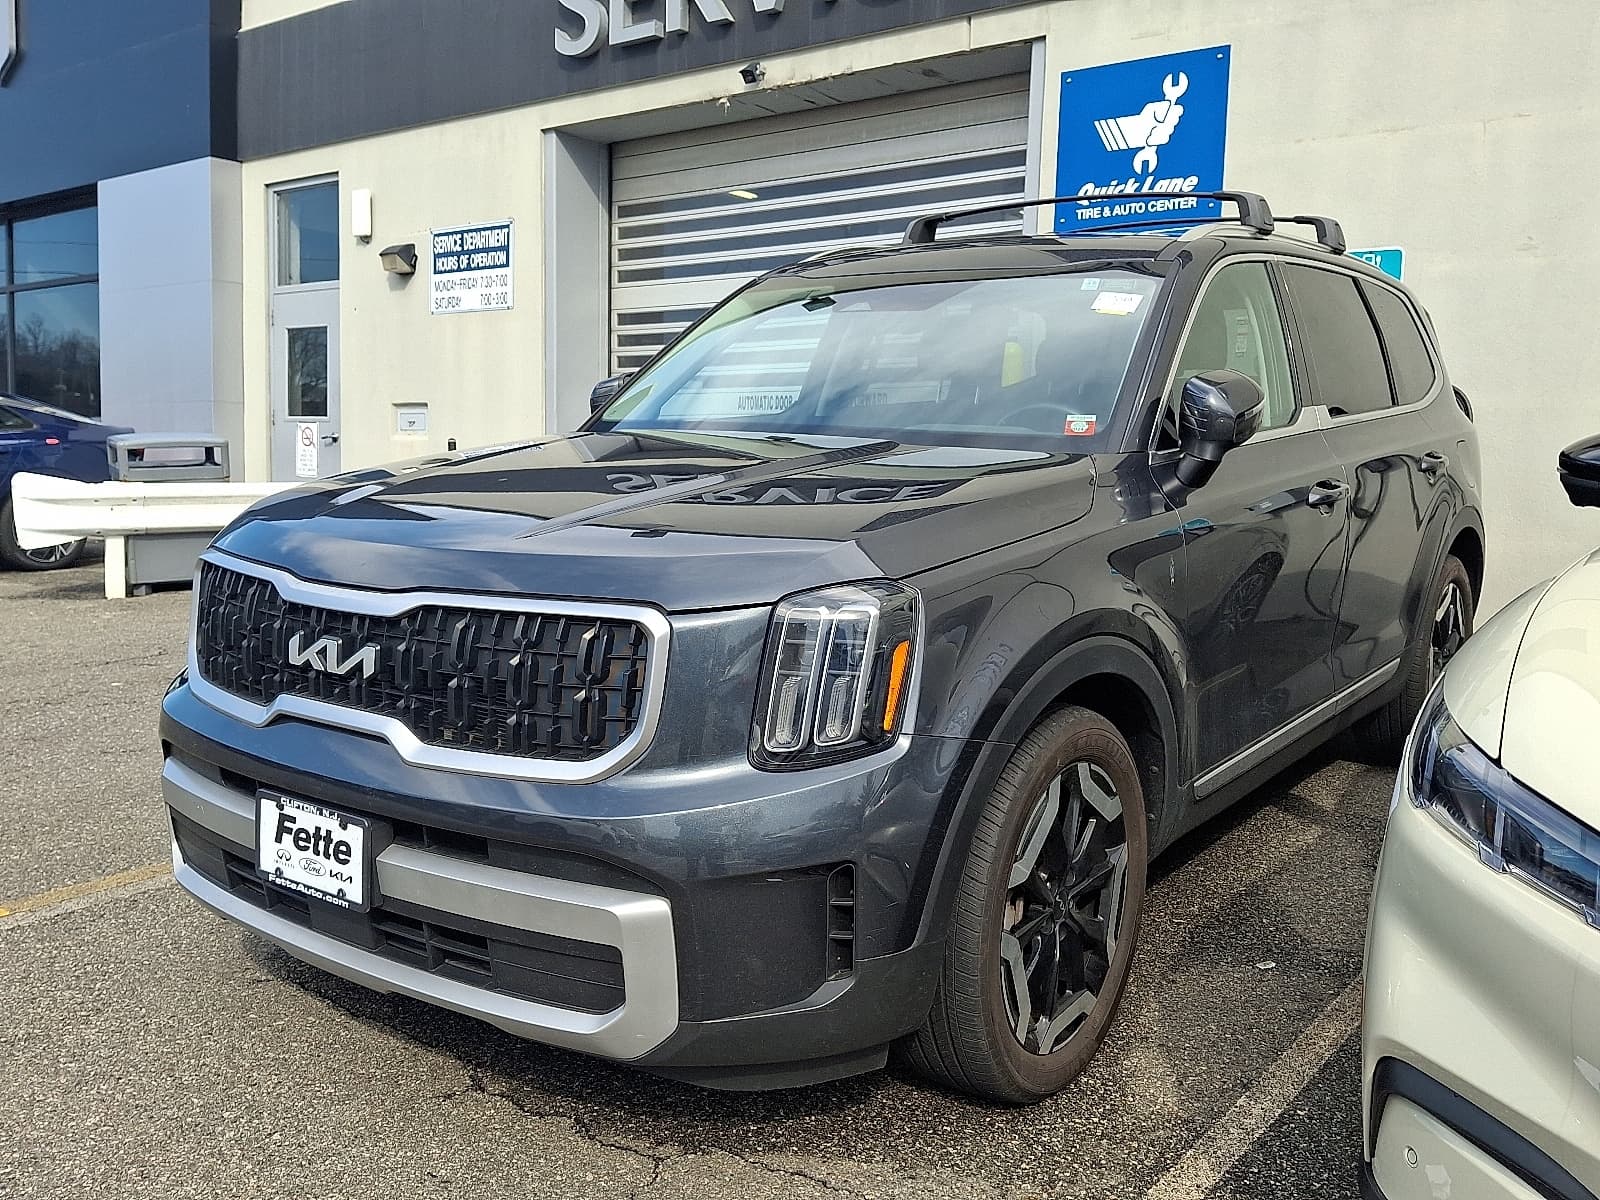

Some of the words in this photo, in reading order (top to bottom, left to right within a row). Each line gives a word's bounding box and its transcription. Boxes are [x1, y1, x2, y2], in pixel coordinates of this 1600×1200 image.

[553, 0, 784, 57] SER
[1076, 177, 1140, 206] Quick
[1141, 175, 1199, 197] Lane
[1076, 207, 1101, 221] TIRE
[1103, 206, 1111, 218] &
[1112, 202, 1146, 217] AUTO
[1148, 197, 1198, 213] CENTER
[434, 234, 462, 253] SERVICE
[464, 228, 509, 250] DEPARTMENT
[436, 256, 458, 271] HOURS
[460, 254, 470, 270] OF
[470, 251, 506, 267] OPERATION
[434, 296, 461, 310] SATURDAY
[737, 394, 774, 412] AUTOMATIC
[288, 629, 381, 680] KIA
[274, 812, 352, 866] Fette
[302, 859, 323, 875] Ford
[329, 868, 353, 885] KIA
[268, 873, 351, 909] FetteAuto.com
